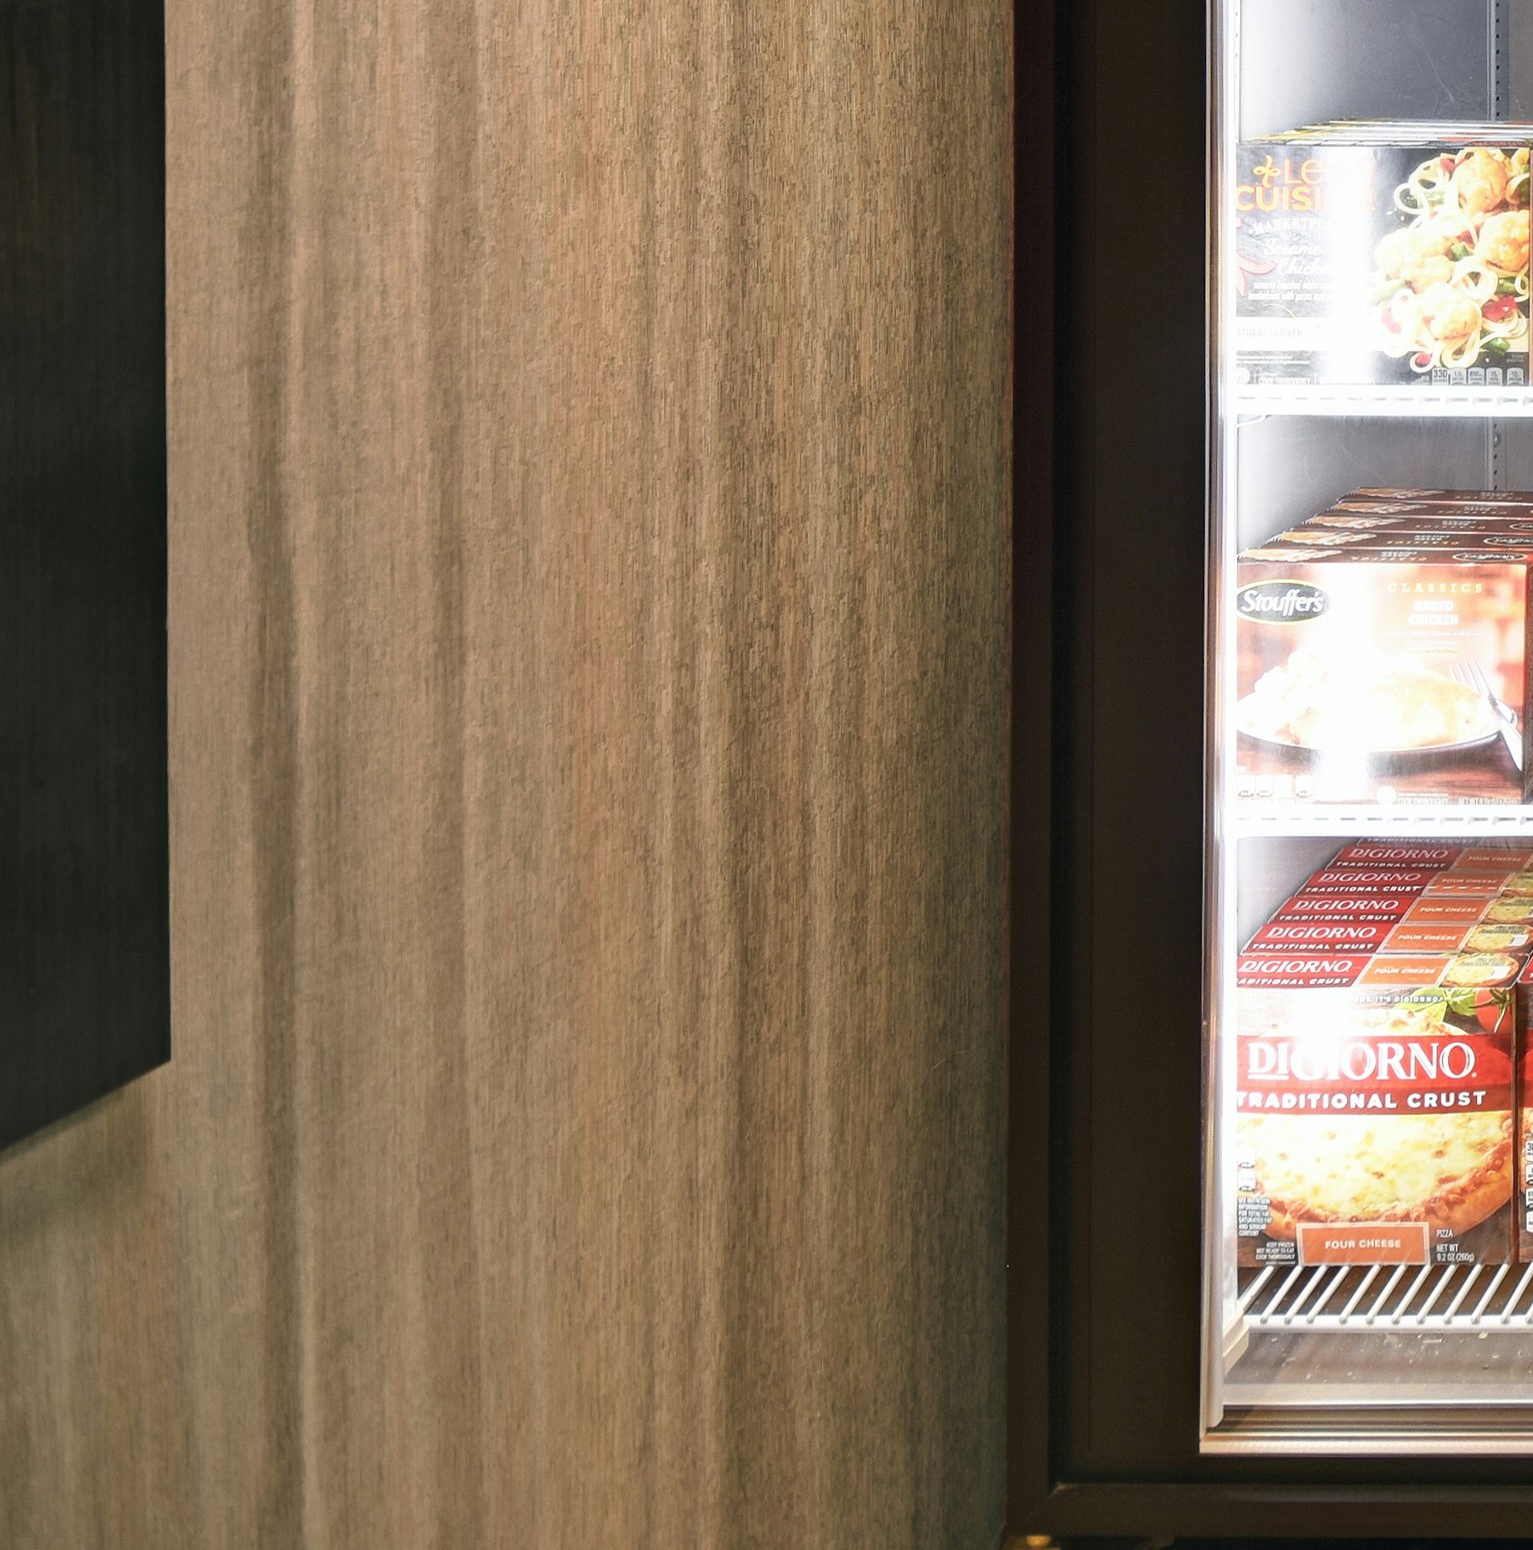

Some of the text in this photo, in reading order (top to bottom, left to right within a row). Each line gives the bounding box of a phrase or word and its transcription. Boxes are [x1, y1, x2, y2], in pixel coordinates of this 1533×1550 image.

[1388, 583, 1484, 593] CLASSICS
[1241, 588, 1324, 617] Stouffer's
[1414, 600, 1454, 611] BAKED
[1408, 614, 1458, 625] CHICKEN
[1266, 927, 1376, 938] DIGIORNO
[1236, 1091, 1486, 1109] TRADITIONAL CRUST
[1325, 1239, 1400, 1249] FOUR CHEESE
